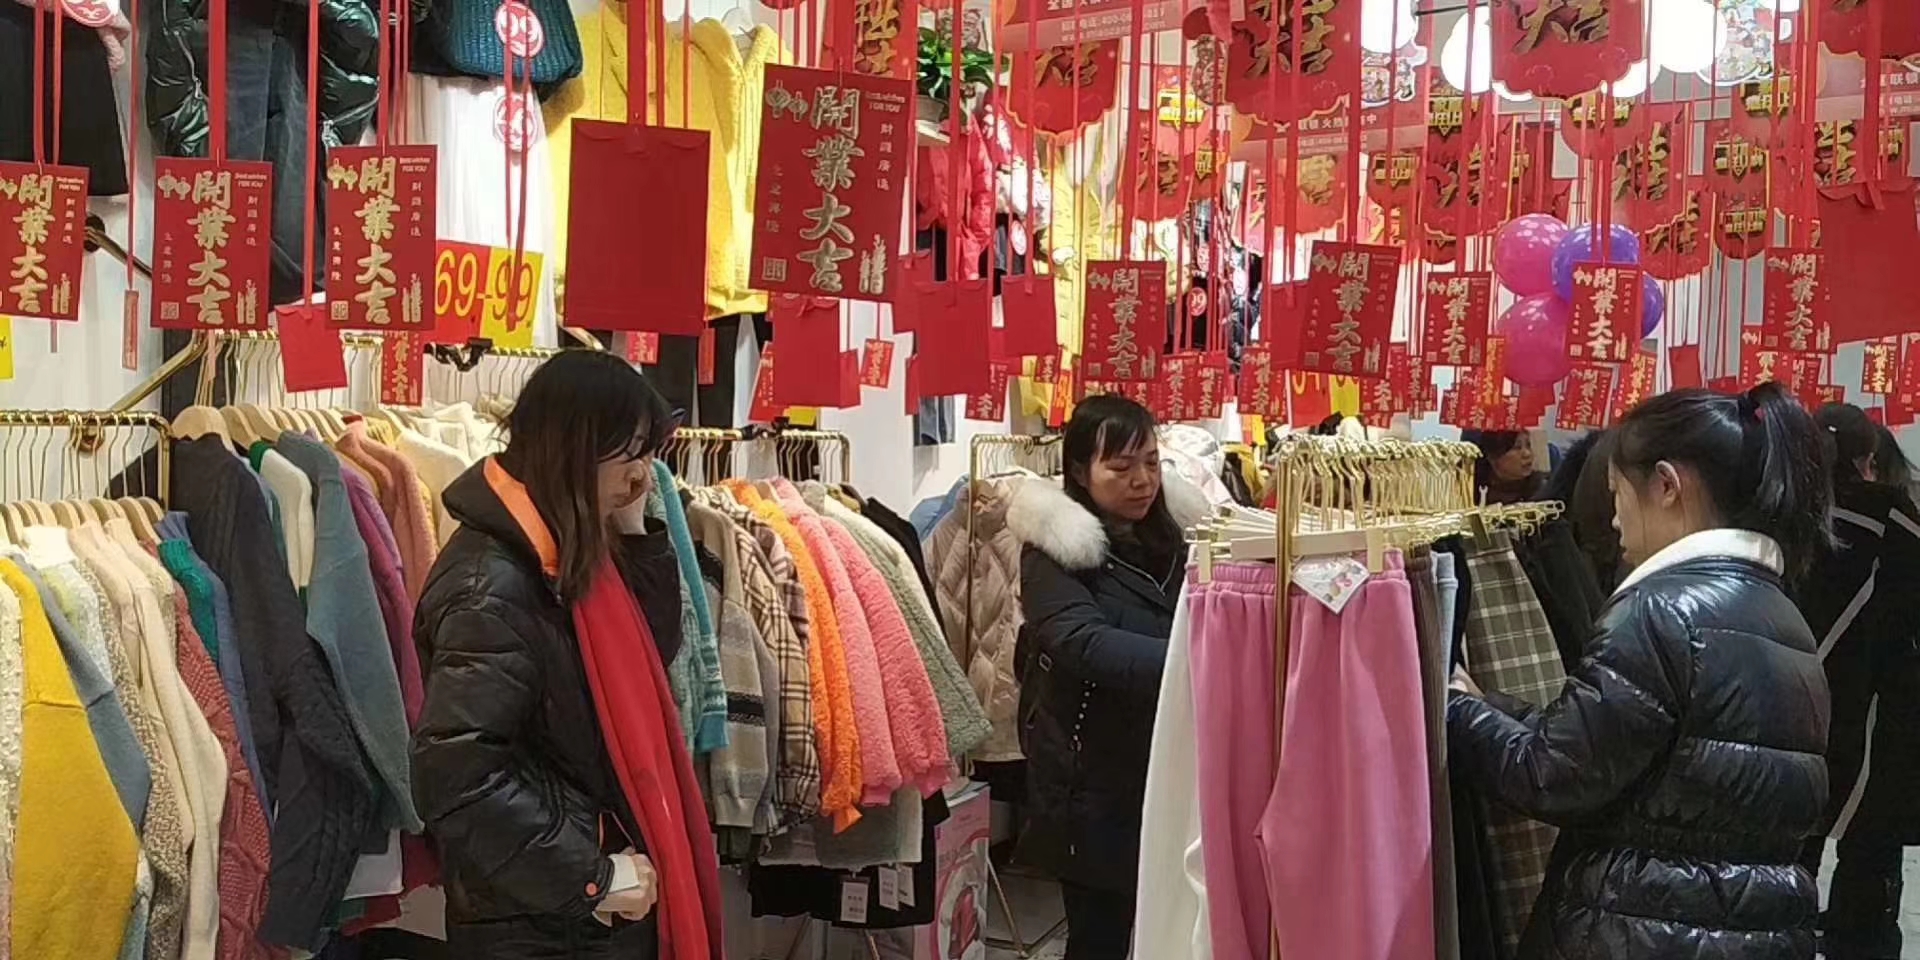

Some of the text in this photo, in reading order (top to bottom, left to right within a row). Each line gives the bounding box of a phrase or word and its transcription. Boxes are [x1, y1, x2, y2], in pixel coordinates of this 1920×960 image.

[9, 174, 56, 314] 開業大吉
[186, 171, 237, 325] 開業大吉
[354, 156, 401, 325] 開業大吉
[796, 85, 864, 292] 開業大吉
[1107, 267, 1143, 379] 開業大吉
[1325, 251, 1371, 374] 開業大吉
[1441, 277, 1472, 364] 開業大吉
[1586, 267, 1619, 360] 開業大吉
[1784, 253, 1819, 351] 開業大吉
